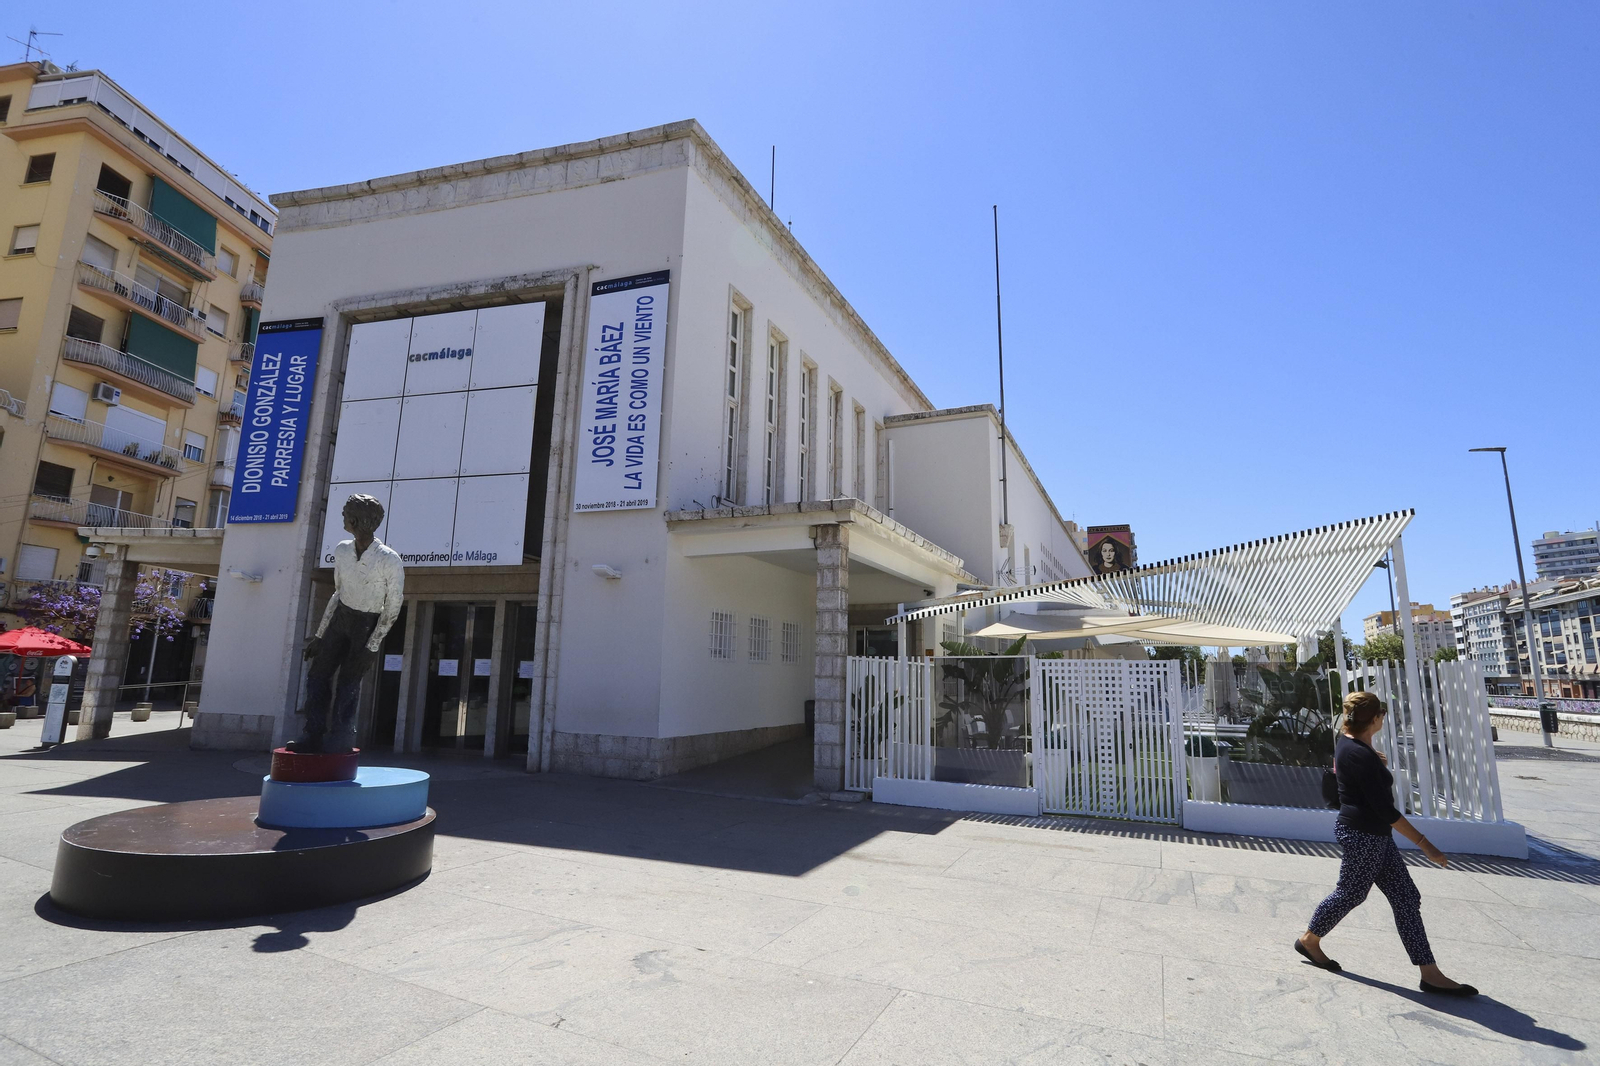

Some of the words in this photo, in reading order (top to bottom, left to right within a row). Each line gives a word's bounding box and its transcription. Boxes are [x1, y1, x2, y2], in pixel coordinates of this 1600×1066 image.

[596, 281, 633, 291] cacmálaga
[262, 323, 293, 331] cacmálaga
[634, 295, 655, 347] VIENTO
[409, 347, 472, 362] cacmálaga
[594, 321, 625, 367] BÁEZ
[632, 346, 651, 365] UN
[252, 352, 283, 427] GONZÁLEZ
[286, 355, 308, 402] LUGAR
[591, 366, 621, 420] MARÍA
[628, 368, 649, 410] COMO
[282, 404, 294, 415] Y
[627, 413, 646, 432] ES
[241, 430, 270, 493] DIONISIO
[271, 417, 298, 487] PARRESIA
[588, 422, 617, 467] JOSÉ
[625, 434, 645, 469] VIDA
[623, 472, 643, 490] LA
[400, 552, 449, 565] temporáneo
[452, 551, 463, 562] de
[465, 550, 497, 563] Málaga
